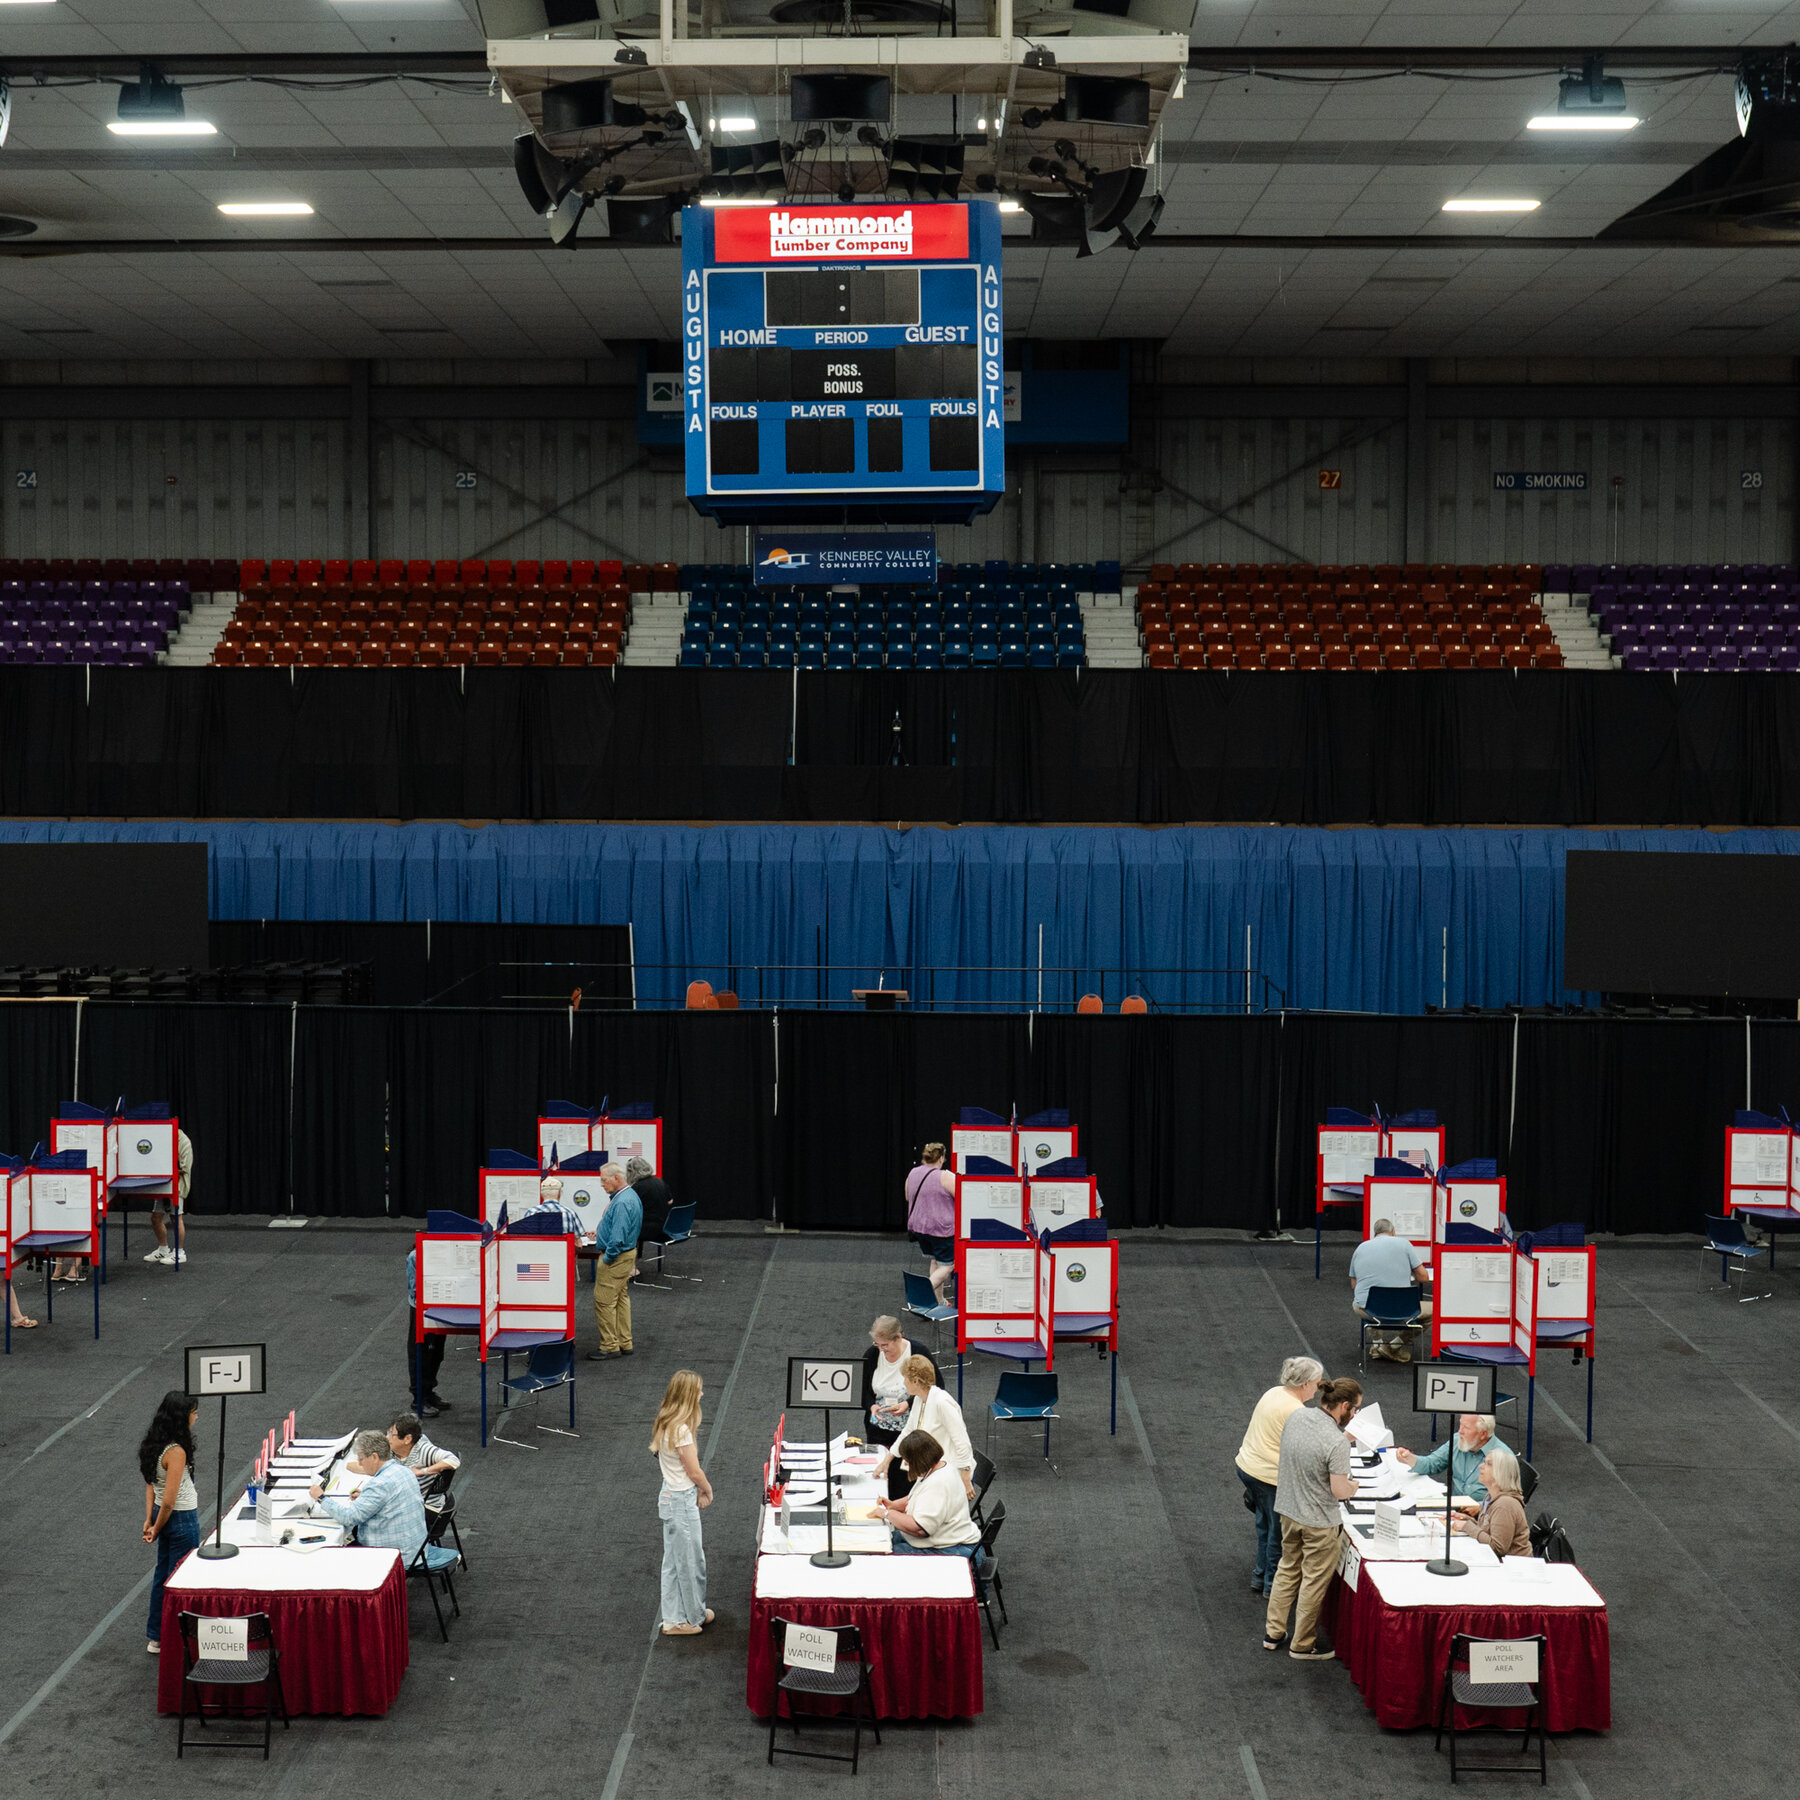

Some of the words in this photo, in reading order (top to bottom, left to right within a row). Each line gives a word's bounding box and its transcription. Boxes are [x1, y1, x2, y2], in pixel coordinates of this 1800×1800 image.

[769, 210, 913, 235] Hammond
[775, 239, 830, 252] Lumber
[835, 238, 909, 253] Company
[720, 329, 778, 345] HOME
[815, 332, 868, 344] PERIOD
[905, 326, 969, 343] GUEST
[686, 269, 703, 433] AUGUSTA
[984, 265, 1001, 428] AUGUSTA
[827, 364, 861, 377] POSS.
[824, 381, 863, 394] BONUS
[711, 405, 757, 419] FOULS
[791, 405, 846, 417] PLAYER
[866, 403, 903, 416] FOUL
[930, 402, 976, 416] FOULS
[17, 472, 37, 487] 24
[456, 472, 477, 488] 25
[1320, 471, 1340, 487] 27
[1496, 475, 1514, 487] NO
[1525, 474, 1585, 488] SMOKING
[1742, 472, 1762, 488] 28
[819, 551, 883, 562] KENNEBEC
[886, 550, 931, 561] VALLEY
[209, 1361, 242, 1384] F-J
[804, 1369, 850, 1391] K-O
[1431, 1379, 1475, 1402] P-T
[210, 1625, 234, 1634] POLL
[799, 1632, 823, 1644] POLL
[201, 1642, 245, 1652] WATCHER
[787, 1647, 833, 1663] WATCHER
